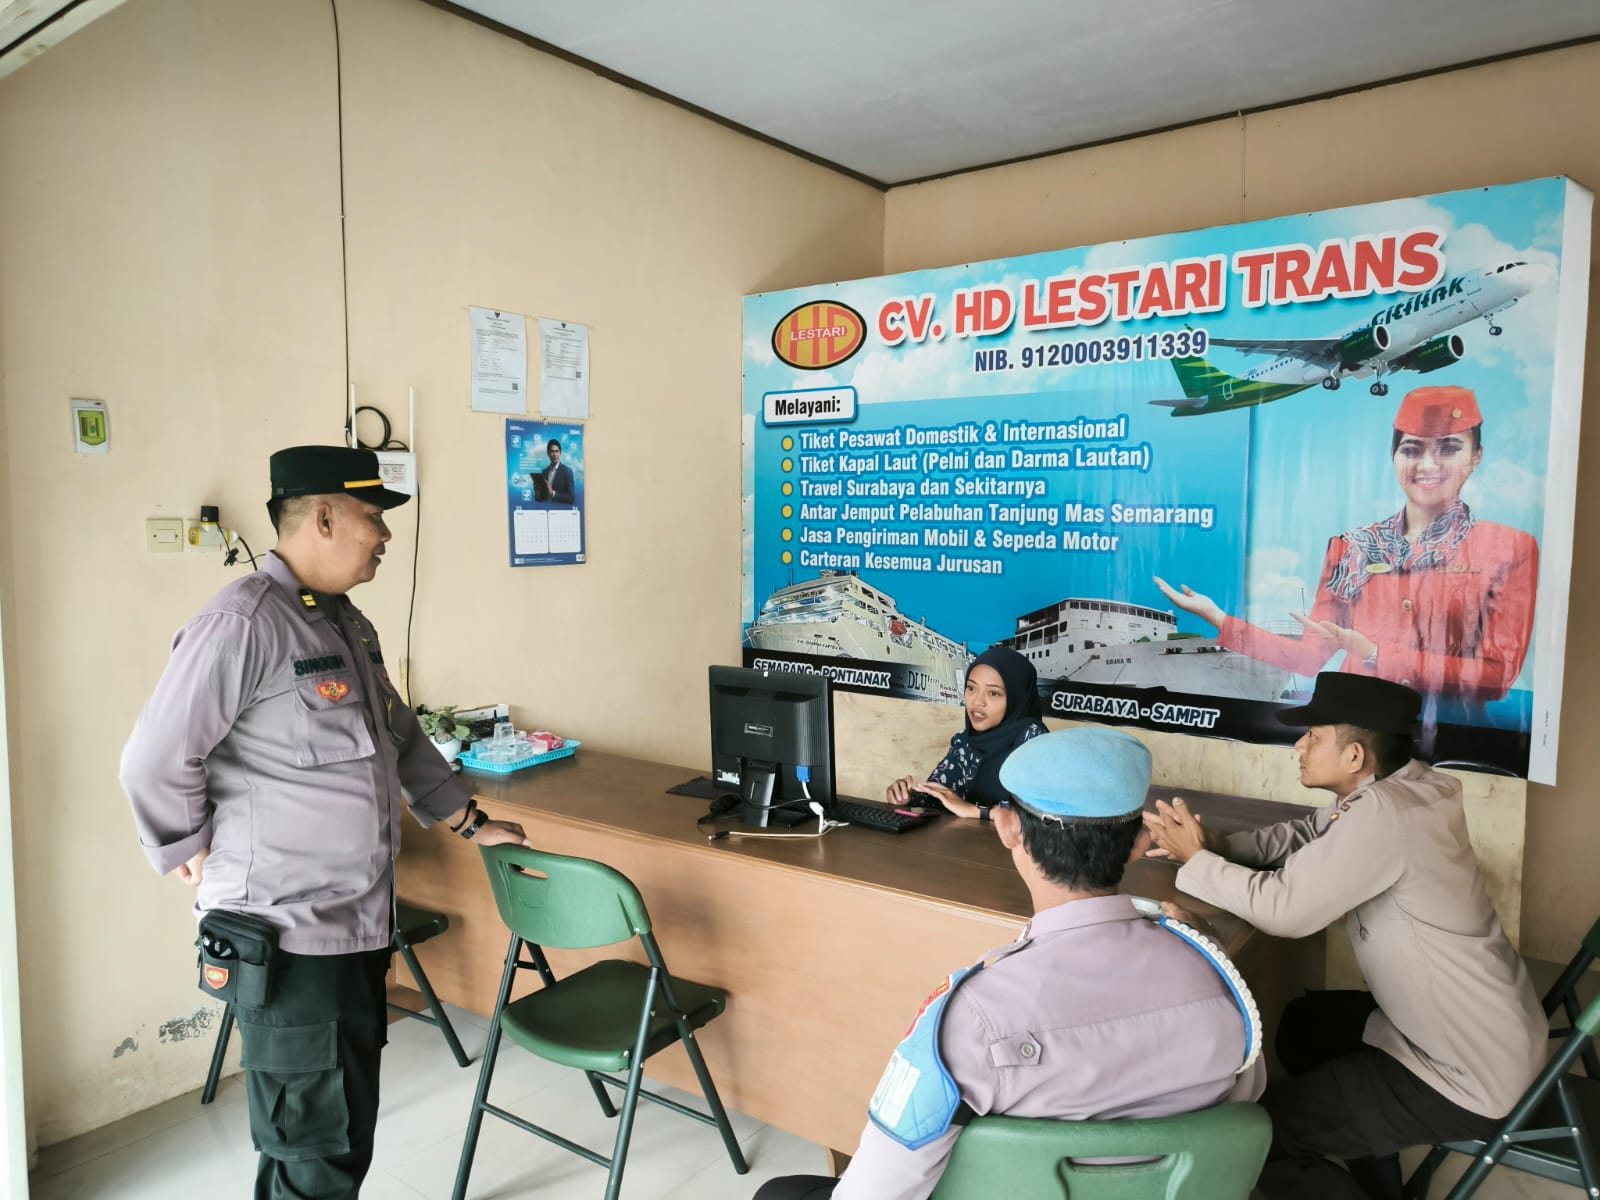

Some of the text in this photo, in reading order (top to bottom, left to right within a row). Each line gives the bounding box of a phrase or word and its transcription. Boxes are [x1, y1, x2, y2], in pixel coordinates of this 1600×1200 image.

[878, 231, 1440, 342] CV. HD LESTARI TRANS
[790, 326, 846, 341] LESTARI
[974, 330, 1207, 372] NIB. 9120003911339
[774, 396, 841, 417] Melayani:
[800, 417, 1126, 449] Tiket Pesawat Domestik & Internasional
[800, 445, 1150, 475] Tiket Kapal Laut (Pelni dan Darma Lautan)
[800, 476, 1046, 499] Travel Surabaya dan Sekitarnya
[800, 503, 1214, 528] Antar Jemput Pelabuhan Tanjung Mas Semarang
[800, 527, 1119, 552] Jasa Pengiriman Mobil & Sepeda Motor
[800, 550, 1003, 574] Carteran Kesemua Jurusan
[754, 660, 812, 675] SEMARANG
[823, 667, 890, 687] PONTIANAK
[907, 670, 928, 691] DLU
[1053, 693, 1137, 718] SURABAYA
[1152, 704, 1219, 728] SAMPIT
